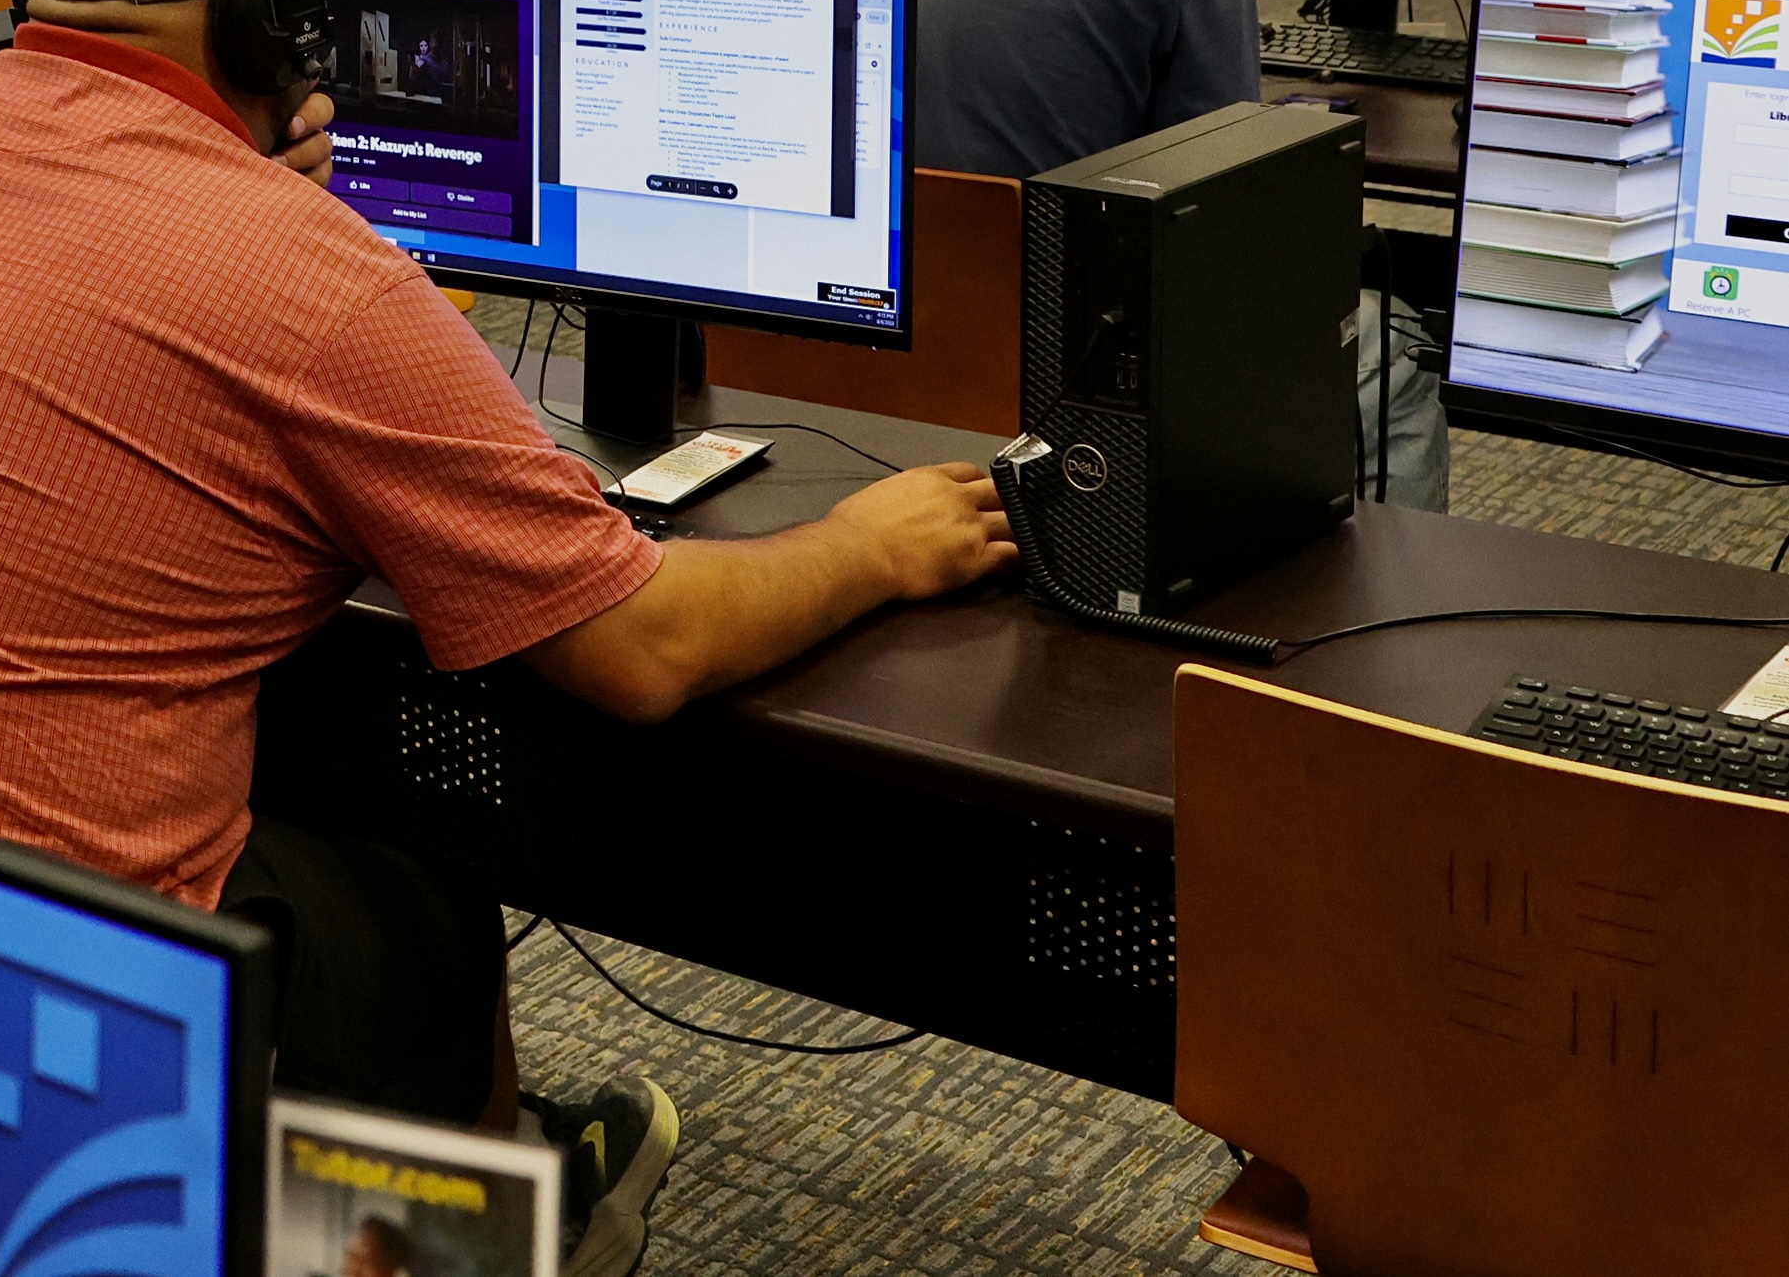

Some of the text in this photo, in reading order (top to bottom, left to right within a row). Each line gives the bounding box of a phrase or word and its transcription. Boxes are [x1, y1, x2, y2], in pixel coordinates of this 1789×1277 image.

[660, 22, 718, 32] EXPERIENCE
[576, 58, 629, 67] EDUCATION
[1745, 90, 1766, 99] Enter
[357, 136, 369, 149] 2:
[370, 136, 424, 158] Kazuya's
[425, 143, 483, 165] Revenge
[457, 193, 475, 203] Dislike
[393, 208, 403, 216] Add
[831, 285, 881, 300] End Session
[842, 295, 858, 303] time:
[1686, 301, 1752, 318] Reserve A PC
[1068, 459, 1102, 478] DELL
